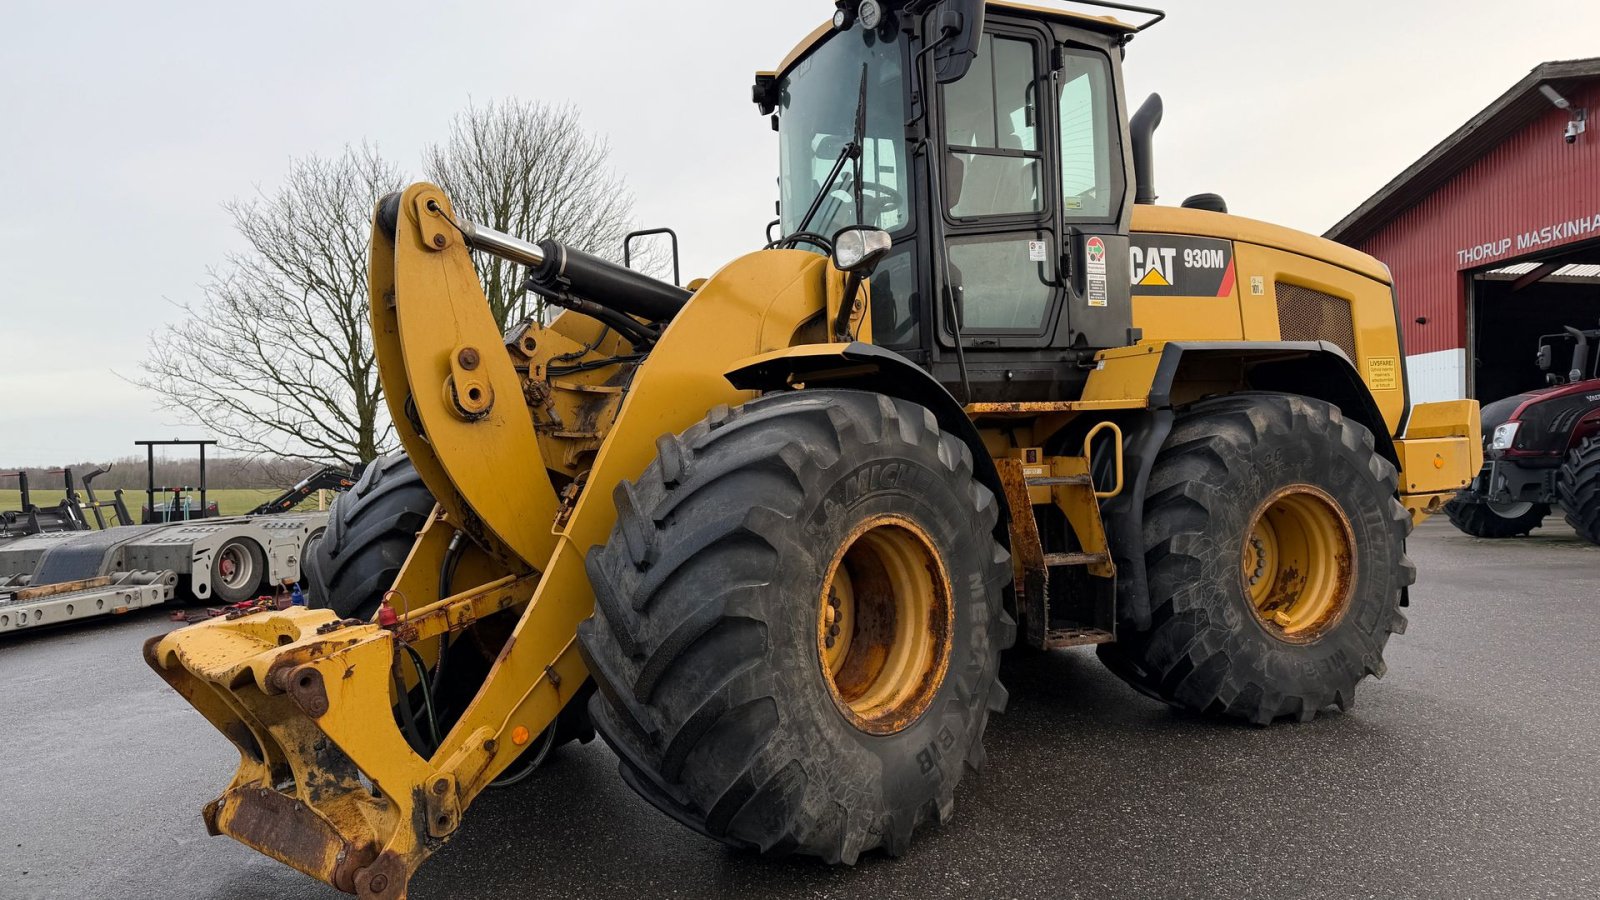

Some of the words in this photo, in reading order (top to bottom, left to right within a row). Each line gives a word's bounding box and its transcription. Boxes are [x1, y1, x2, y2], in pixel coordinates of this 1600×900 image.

[1129, 246, 1176, 286] CAT
[1184, 248, 1224, 269] 930M
[1457, 238, 1512, 265] THORUP
